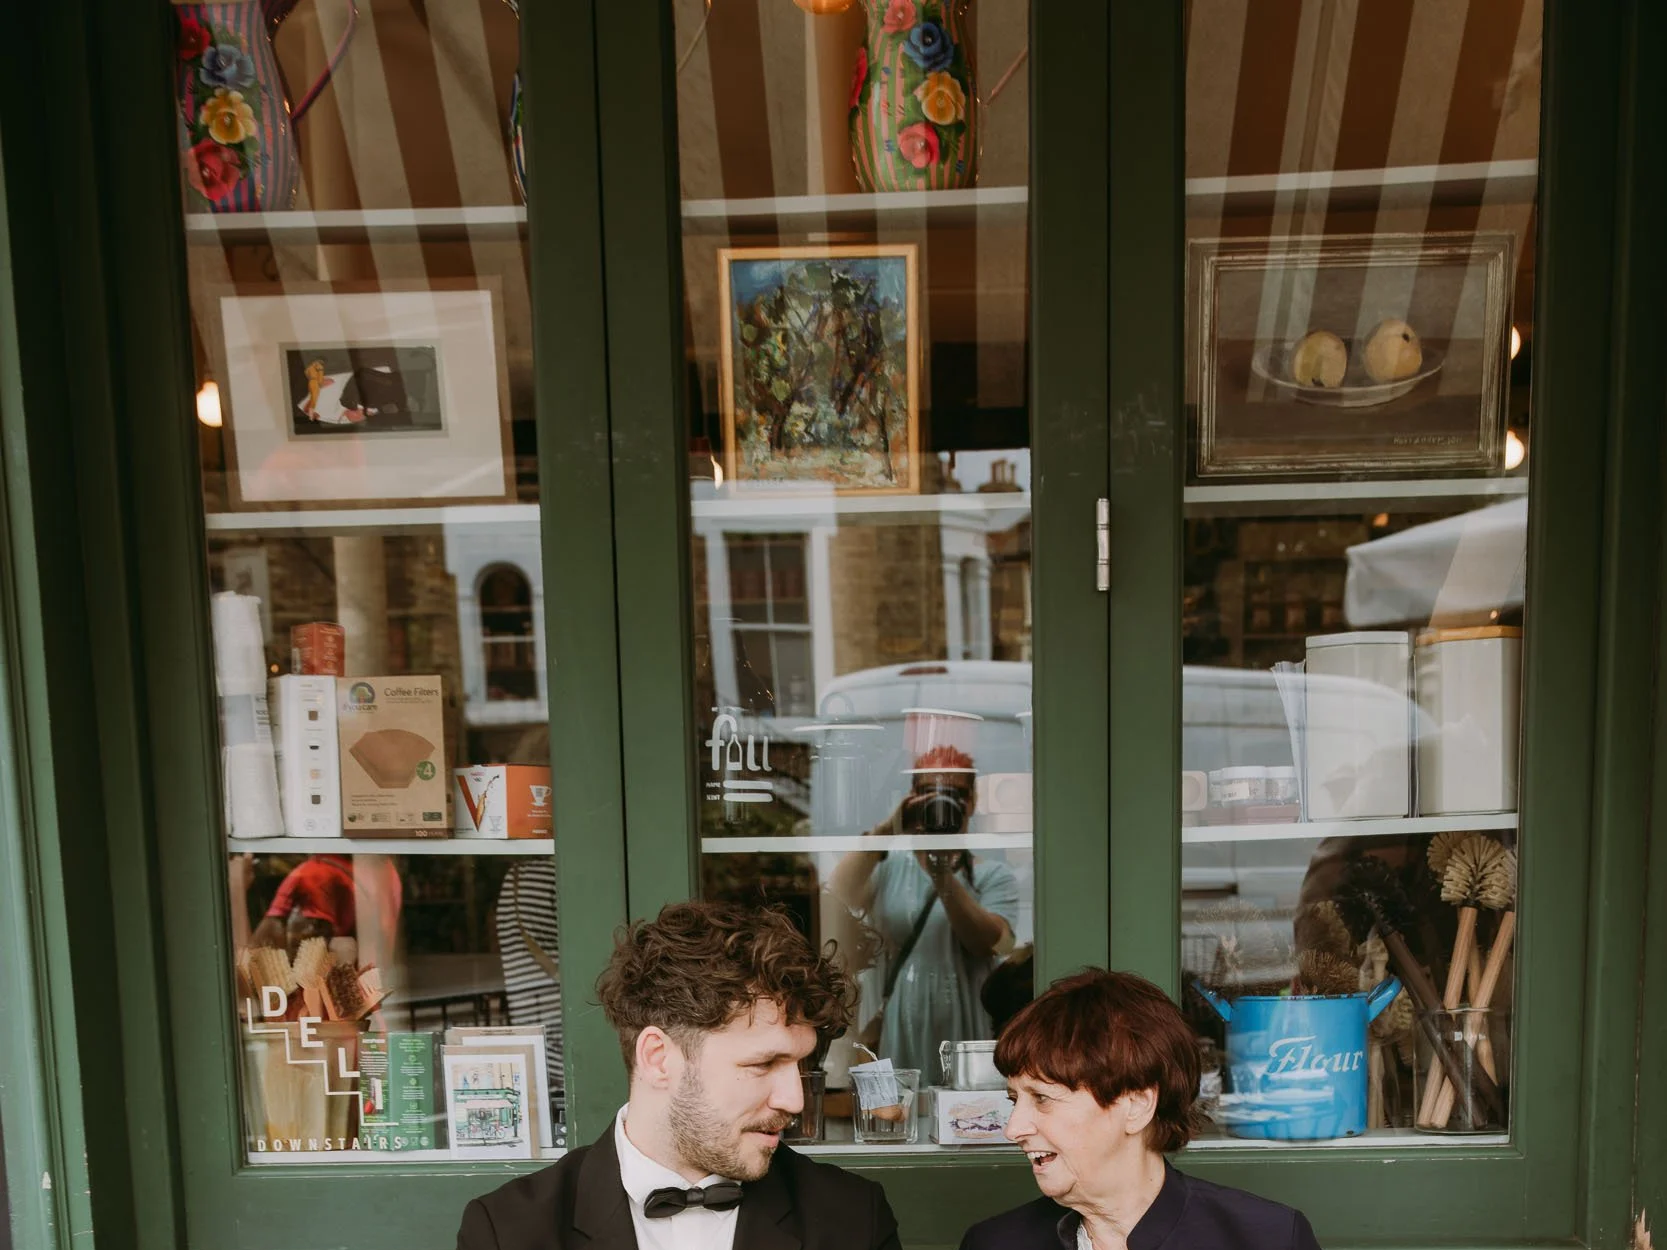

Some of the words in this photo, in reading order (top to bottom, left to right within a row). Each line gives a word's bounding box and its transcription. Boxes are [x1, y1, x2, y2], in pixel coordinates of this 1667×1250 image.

[384, 687, 413, 697] Coffee
[414, 686, 440, 697] Filters
[1265, 1035, 1364, 1076] Flour
[256, 1137, 402, 1152] DOWNSTAIRS
